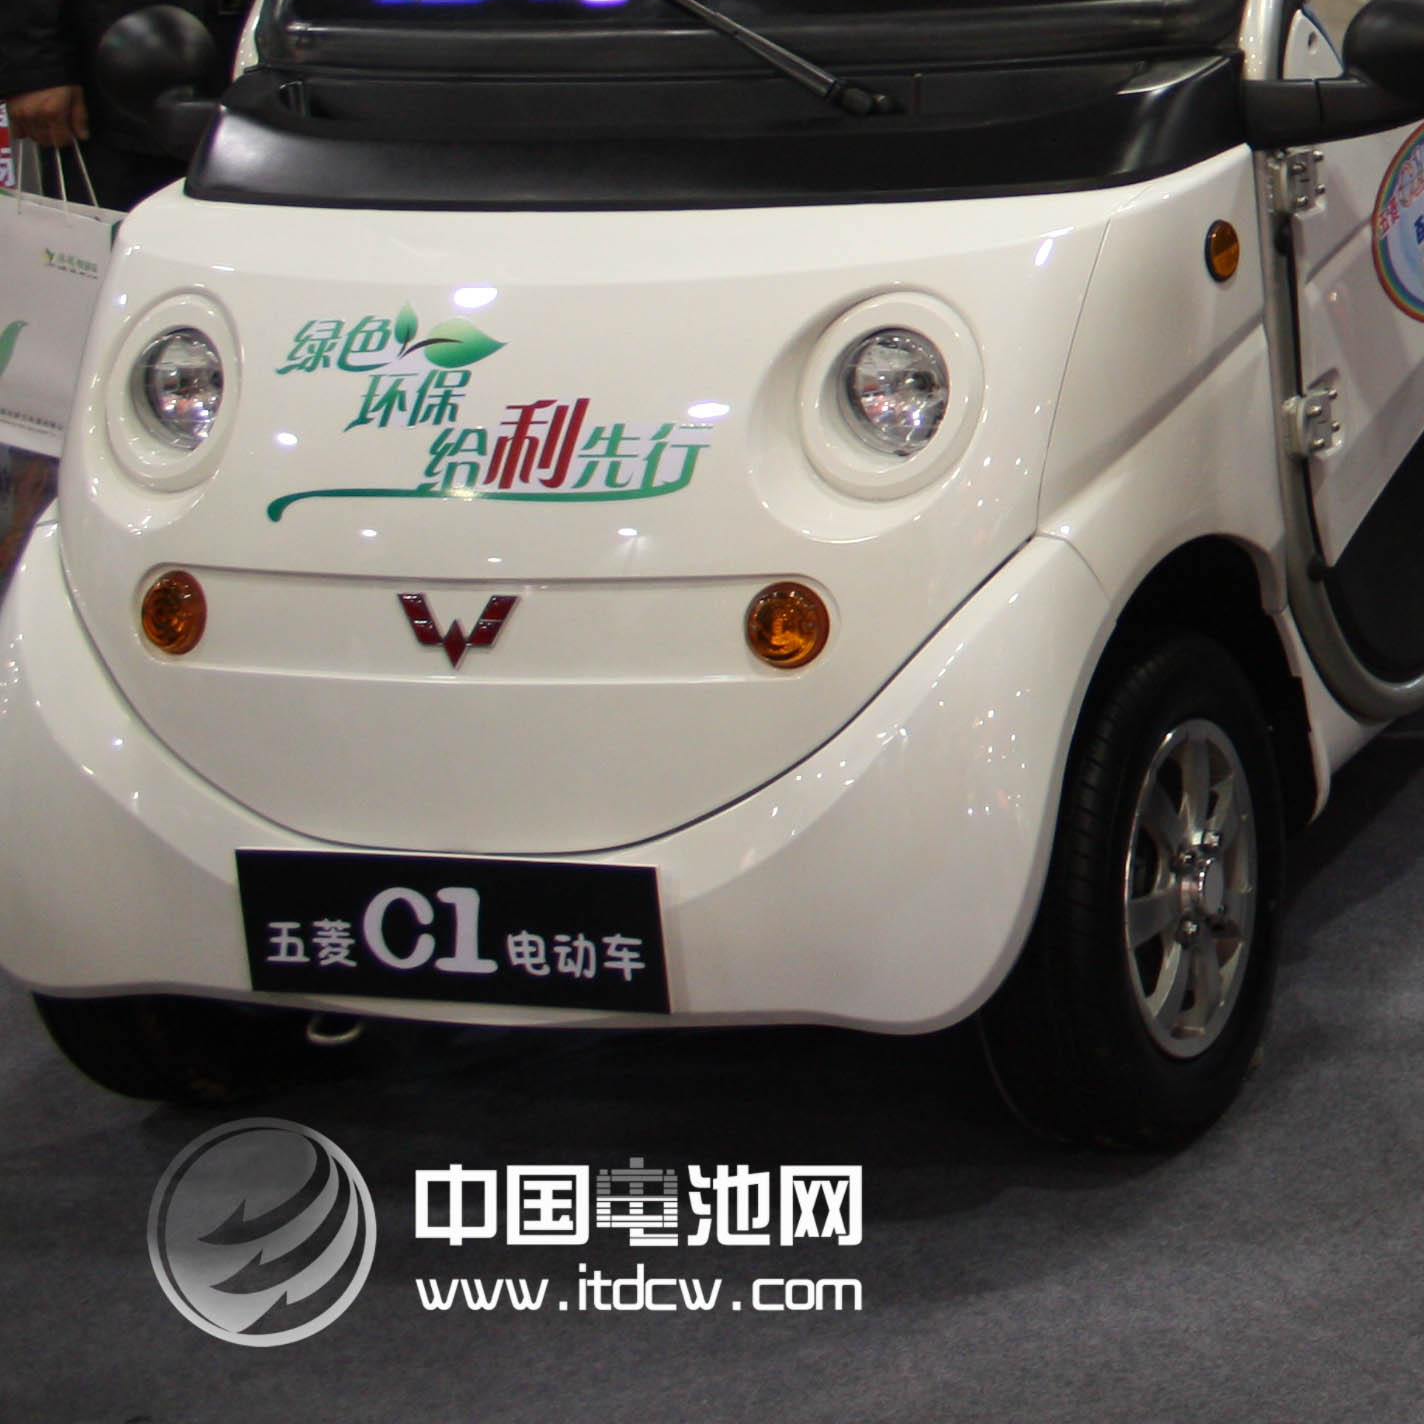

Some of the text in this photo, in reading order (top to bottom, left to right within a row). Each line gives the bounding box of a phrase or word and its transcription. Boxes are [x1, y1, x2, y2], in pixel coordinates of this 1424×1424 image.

[275, 314, 392, 376] 绿色
[342, 367, 473, 433] 环保
[416, 397, 716, 492] 给利先行
[266, 886, 647, 981] 五菱C1电动车
